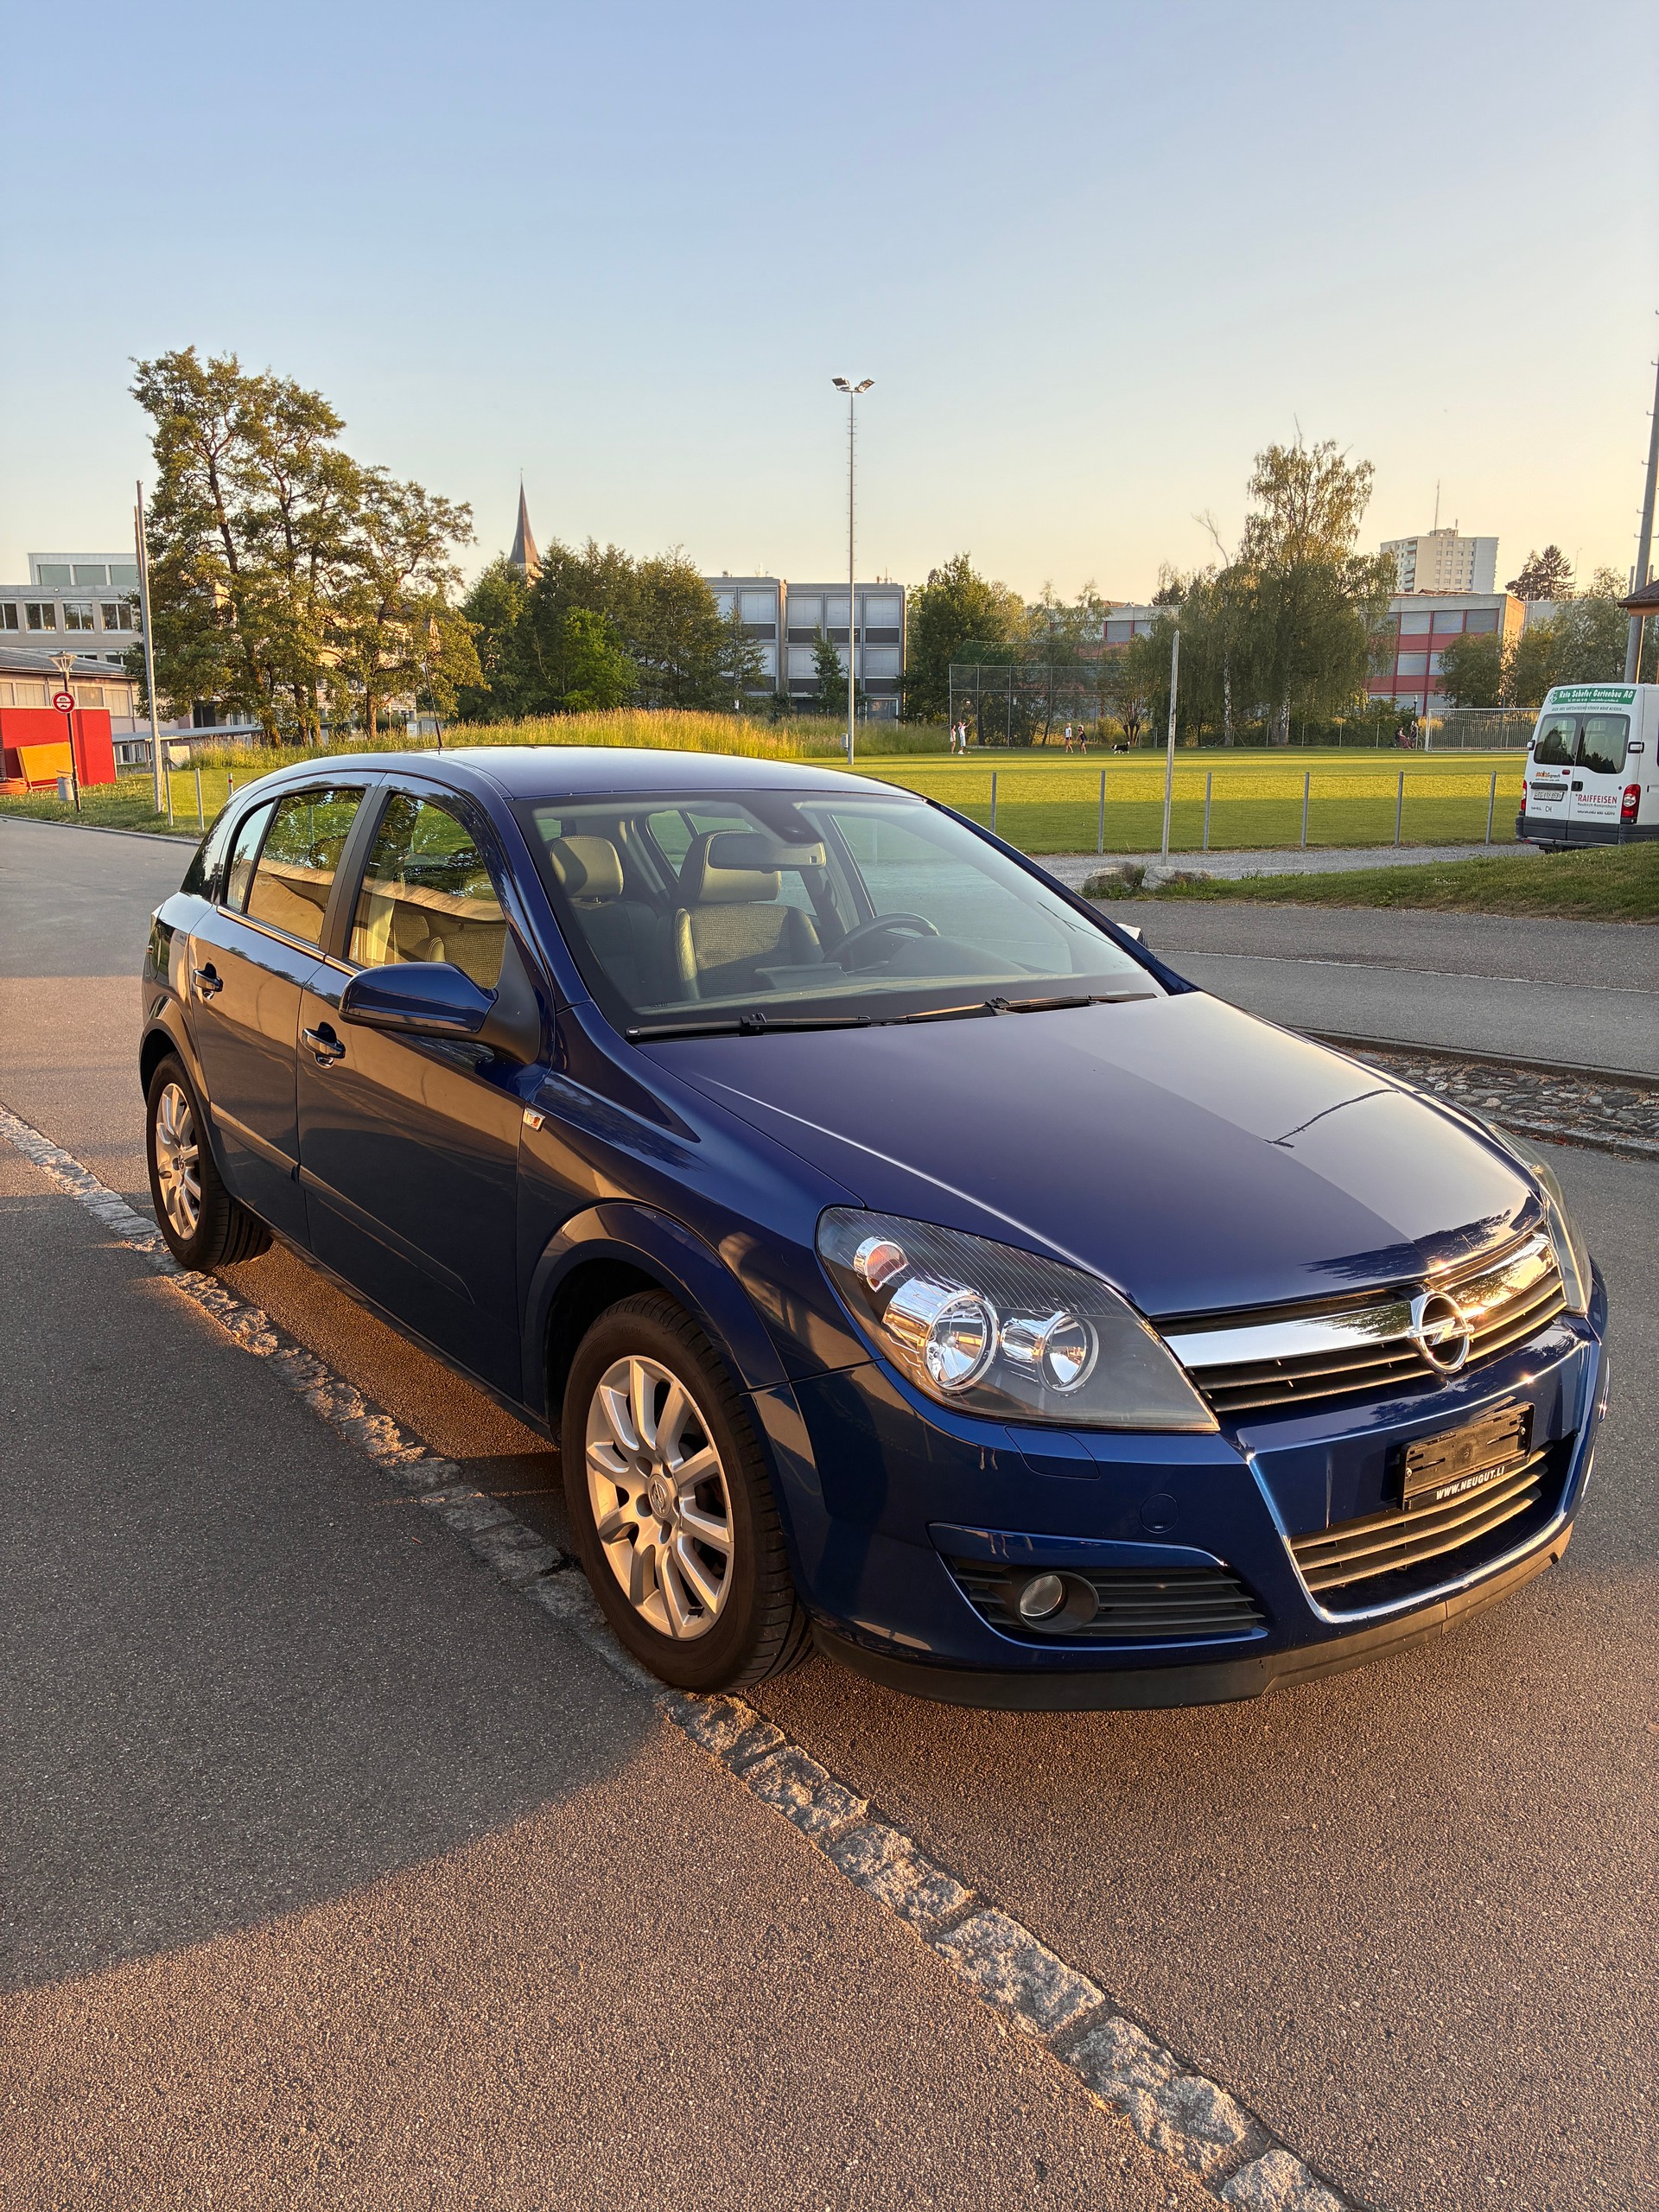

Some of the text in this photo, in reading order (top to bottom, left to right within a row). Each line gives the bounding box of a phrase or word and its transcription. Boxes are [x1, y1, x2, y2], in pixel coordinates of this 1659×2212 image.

[1593, 689, 1622, 698] Gartenbau
[1623, 690, 1634, 698] AG
[1578, 794, 1618, 804] RAIFFEISEN
[1436, 1466, 1504, 1500] WWW.NEUGUT.LI
